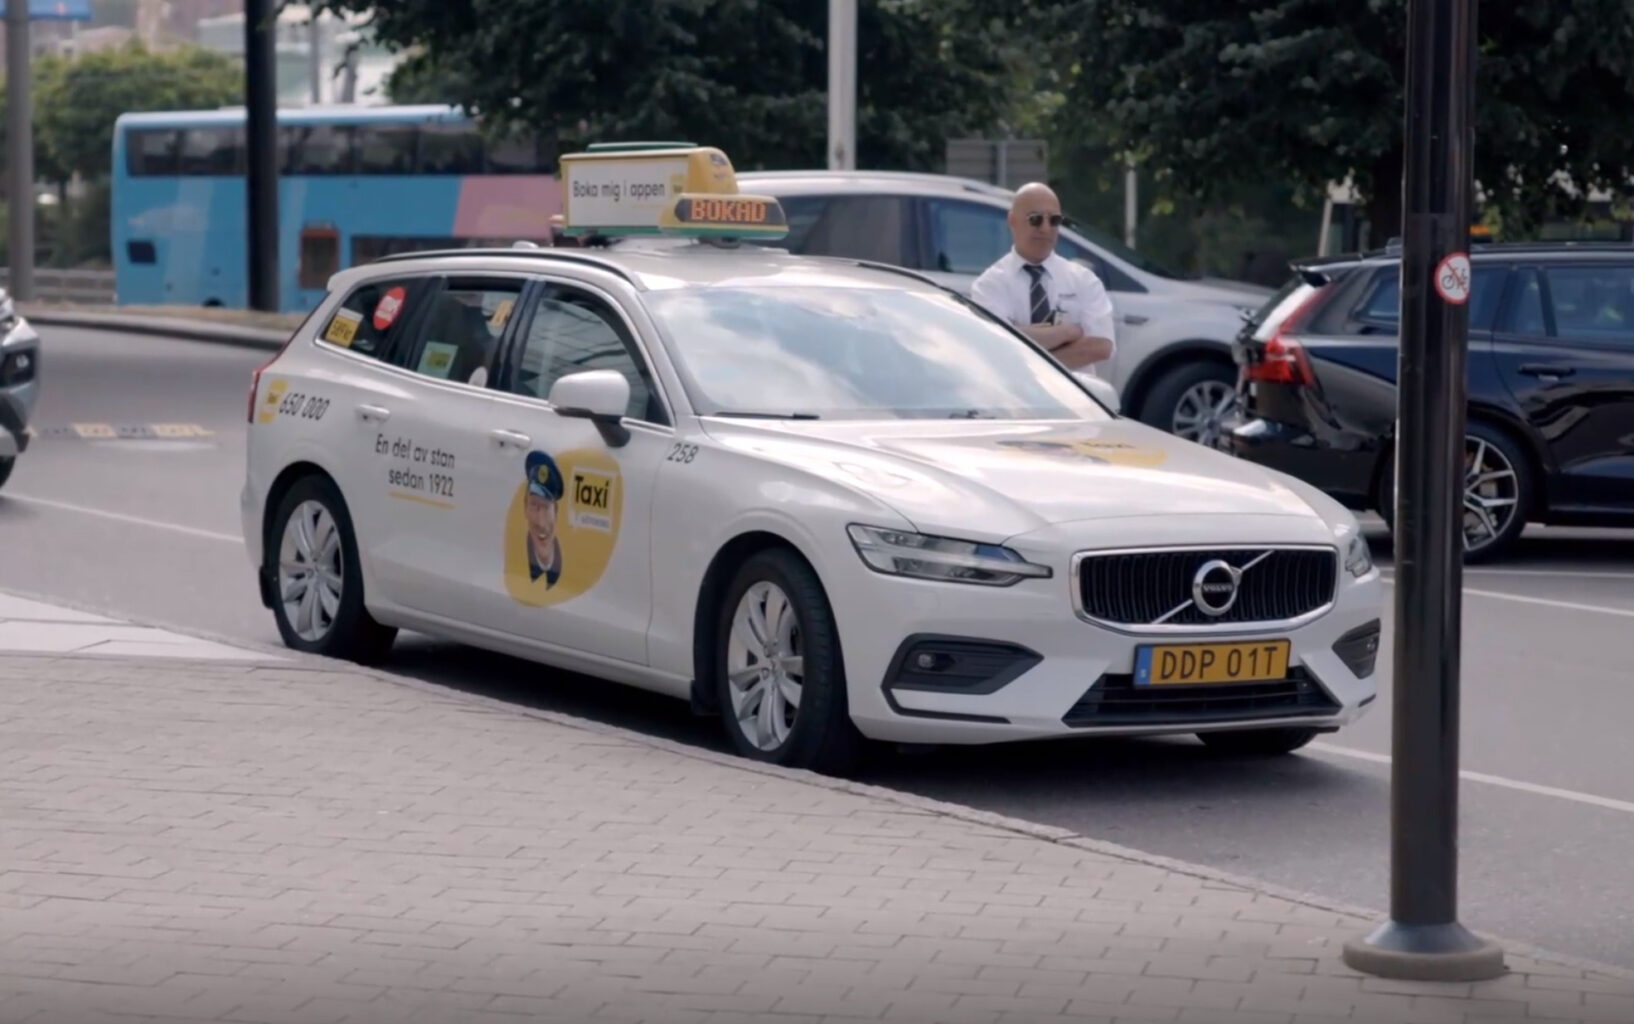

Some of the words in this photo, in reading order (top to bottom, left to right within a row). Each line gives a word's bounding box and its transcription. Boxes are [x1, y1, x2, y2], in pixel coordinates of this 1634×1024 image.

[574, 180, 598, 197] Boka
[601, 180, 620, 202] mig
[630, 183, 665, 200] appen
[279, 392, 305, 415] 650
[301, 396, 330, 420] 000
[375, 433, 388, 454] En
[392, 436, 411, 459] del
[413, 446, 427, 462] av
[430, 447, 454, 469] stan
[667, 442, 698, 463] 258
[388, 466, 424, 490] sedan
[429, 473, 454, 497] 1922
[574, 474, 609, 508] Taxi
[1160, 649, 1215, 679] DDP
[1226, 646, 1277, 676] 01T
